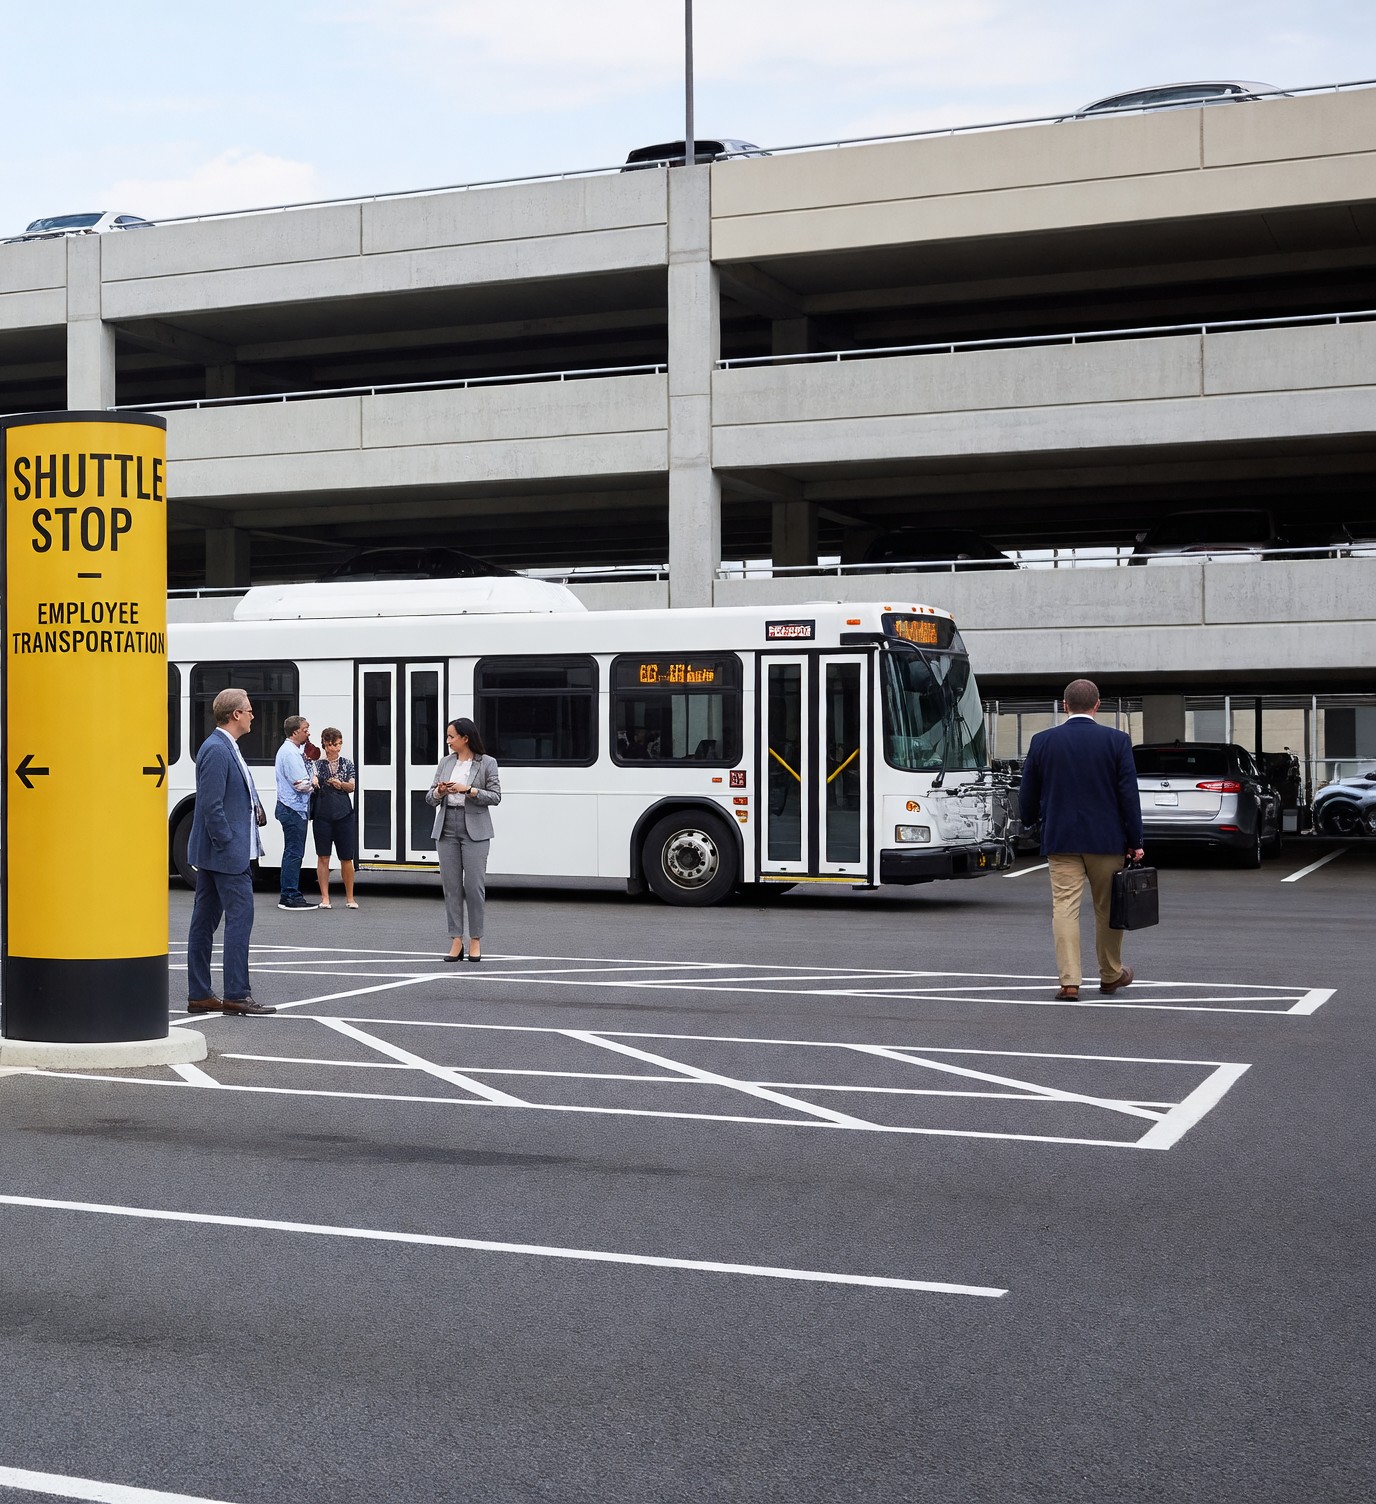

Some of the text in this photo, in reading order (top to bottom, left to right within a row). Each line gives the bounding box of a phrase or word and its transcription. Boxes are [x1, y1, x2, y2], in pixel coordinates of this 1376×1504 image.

[13, 453, 164, 502] SHUTTLE
[31, 507, 133, 553] STOP
[38, 601, 139, 625] EMPLOYEE
[12, 630, 165, 655] TRANSPORTATION
